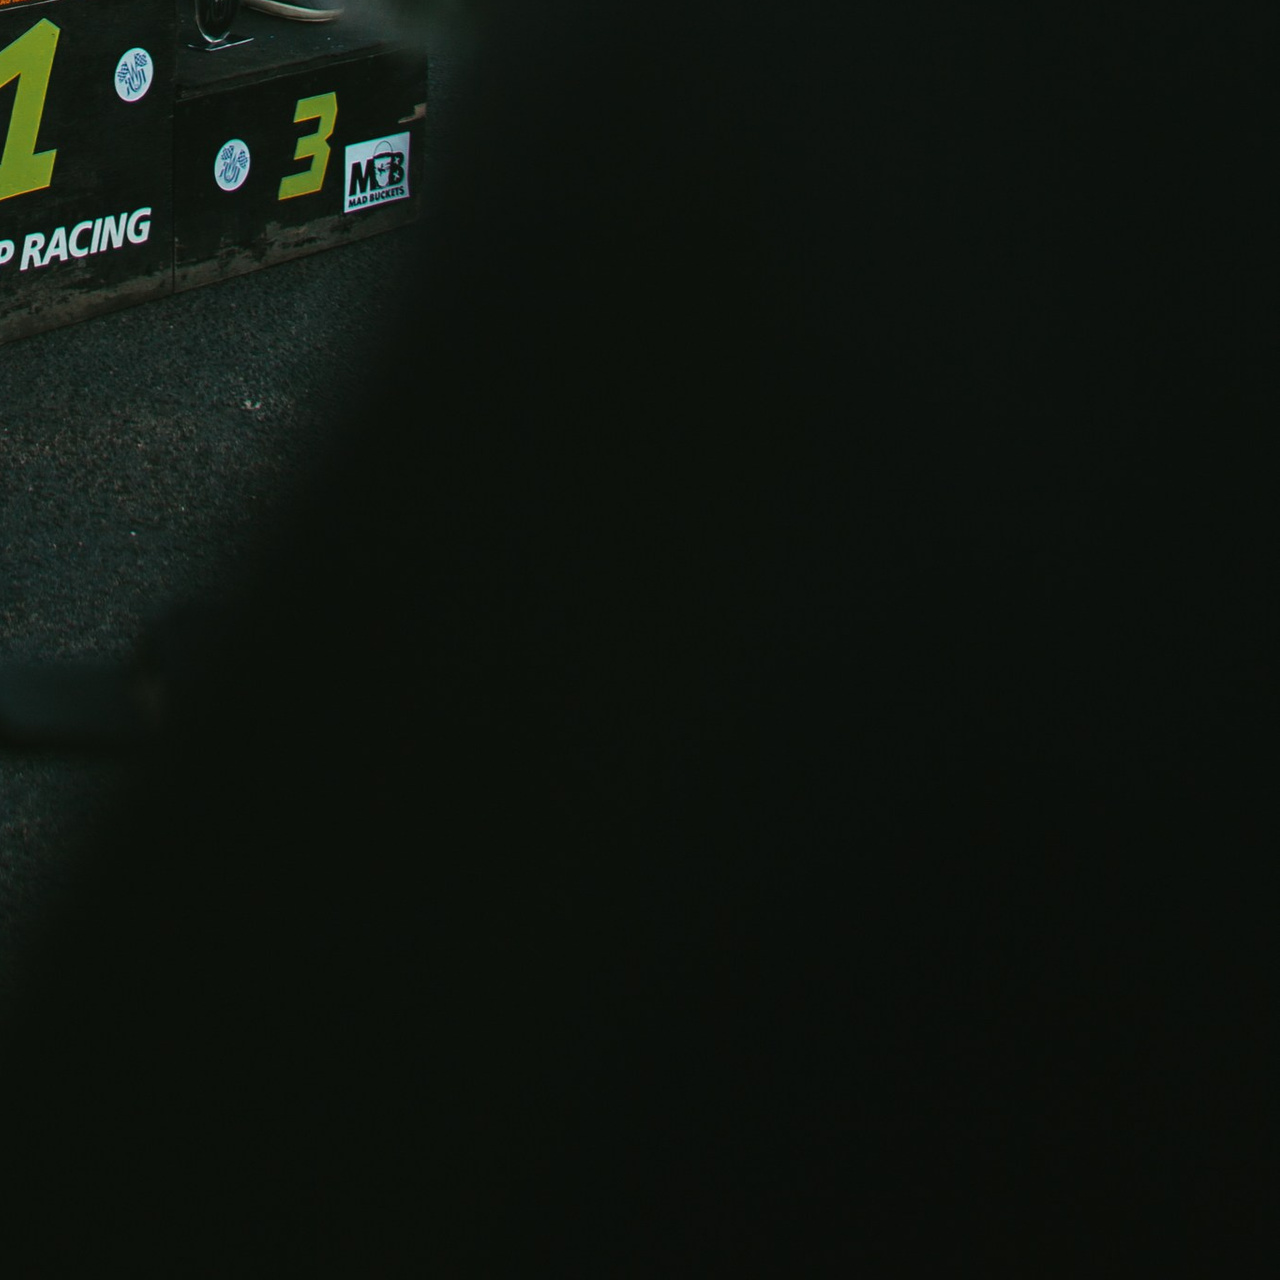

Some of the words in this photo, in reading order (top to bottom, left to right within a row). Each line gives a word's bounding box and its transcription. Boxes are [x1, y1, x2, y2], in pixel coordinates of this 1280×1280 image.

[278, 91, 338, 201] 3
[348, 195, 368, 208] MAD
[369, 185, 405, 203] BUCKETS
[20, 207, 152, 271] RACING
